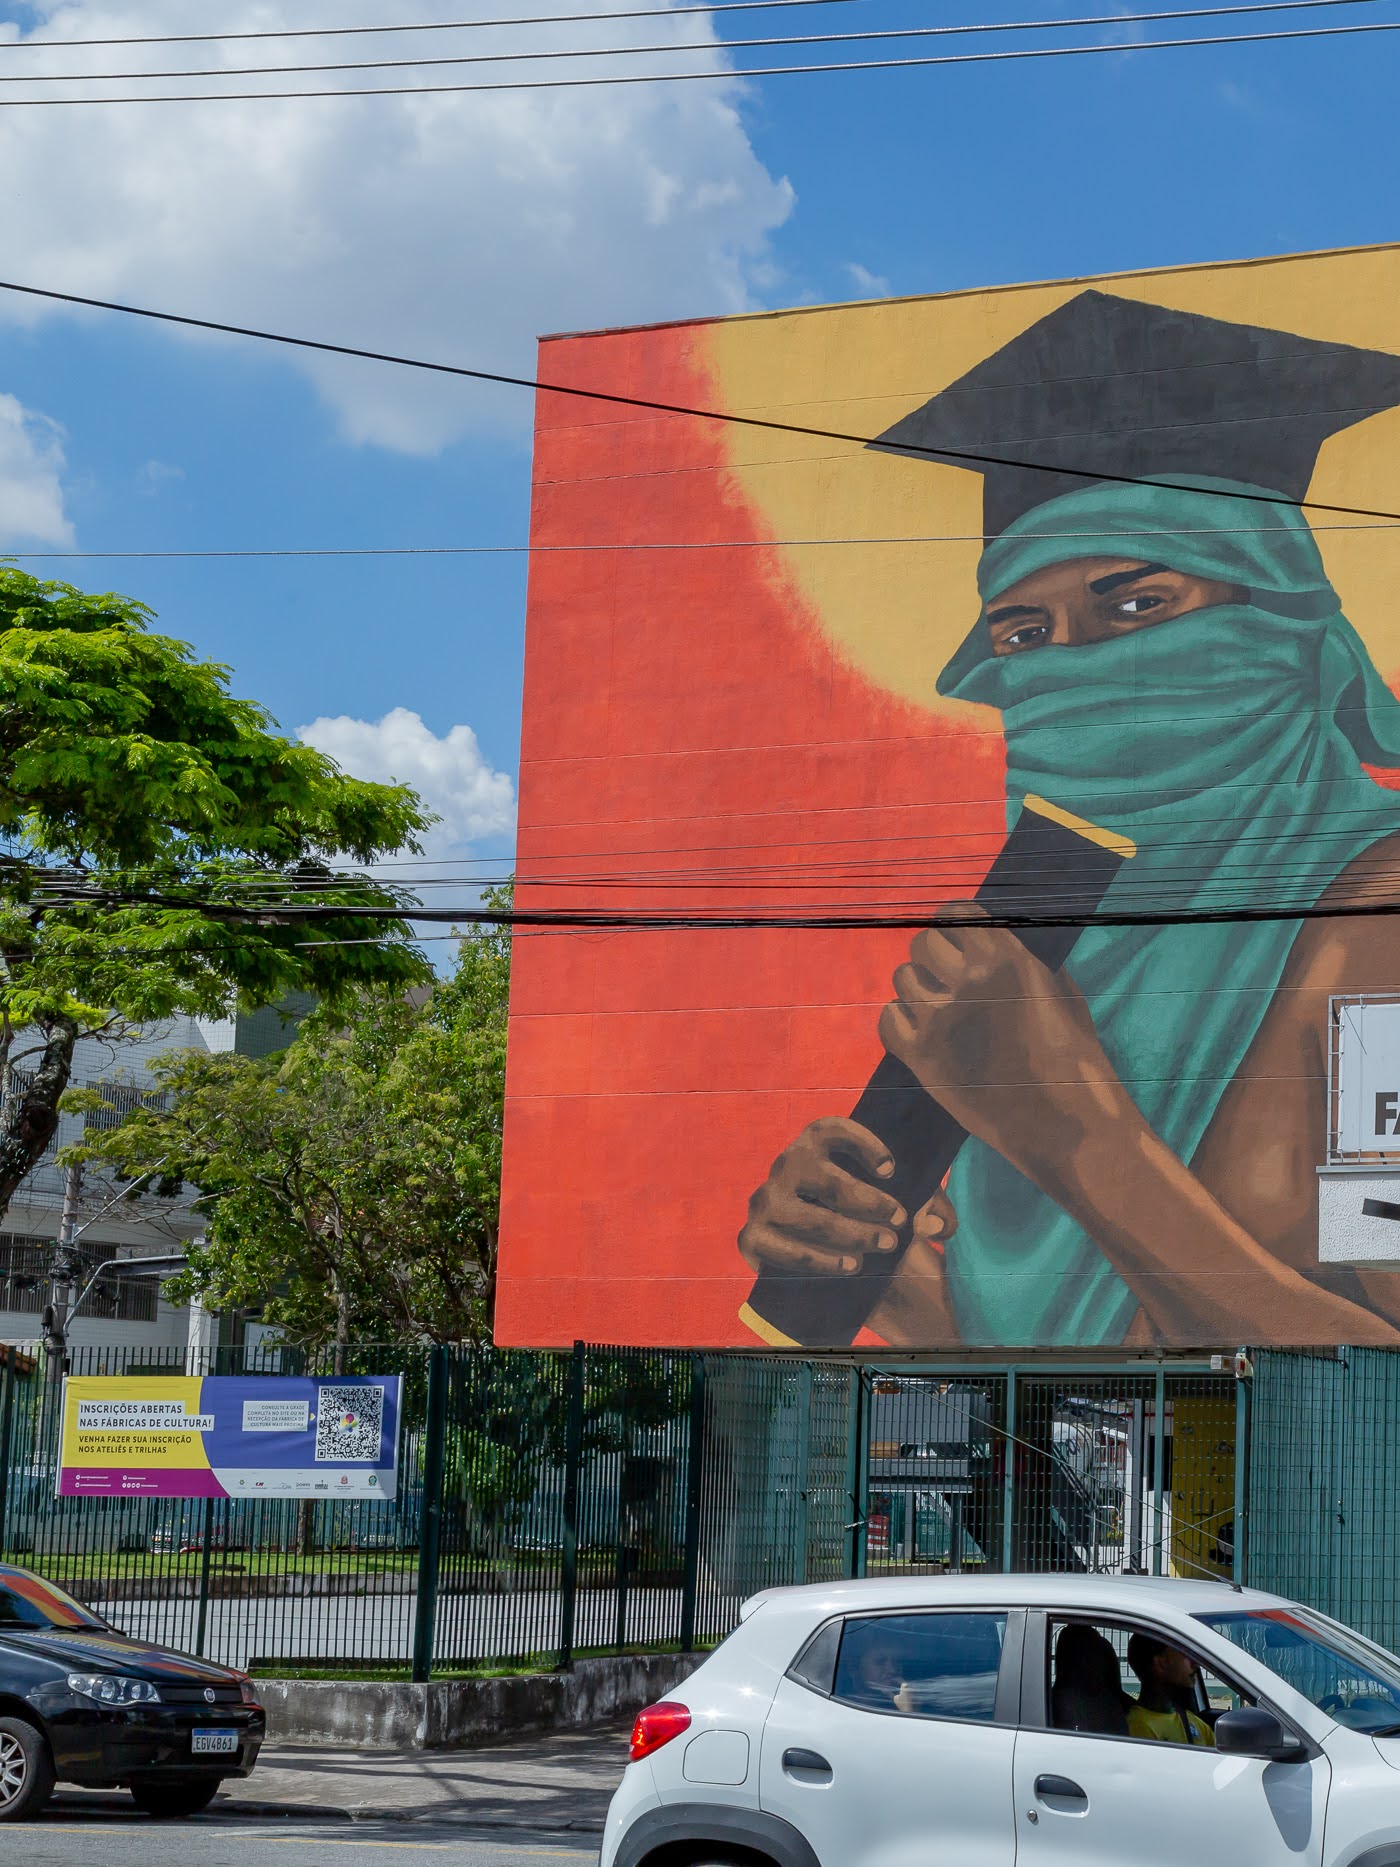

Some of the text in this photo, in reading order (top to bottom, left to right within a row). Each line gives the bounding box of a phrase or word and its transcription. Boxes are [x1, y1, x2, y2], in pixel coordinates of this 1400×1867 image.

[80, 1403, 182, 1415] INSCRIÇÕES ABERTAS
[79, 1417, 211, 1428] NAS FÁBRICAS DE CULTURA!
[79, 1435, 105, 1443] VENHA
[150, 1434, 192, 1445] INSCRIÇÃO
[96, 1444, 127, 1453] ATELIÊS
[135, 1446, 167, 1454] TRILHAS
[196, 1737, 232, 1750] EGV4B61
